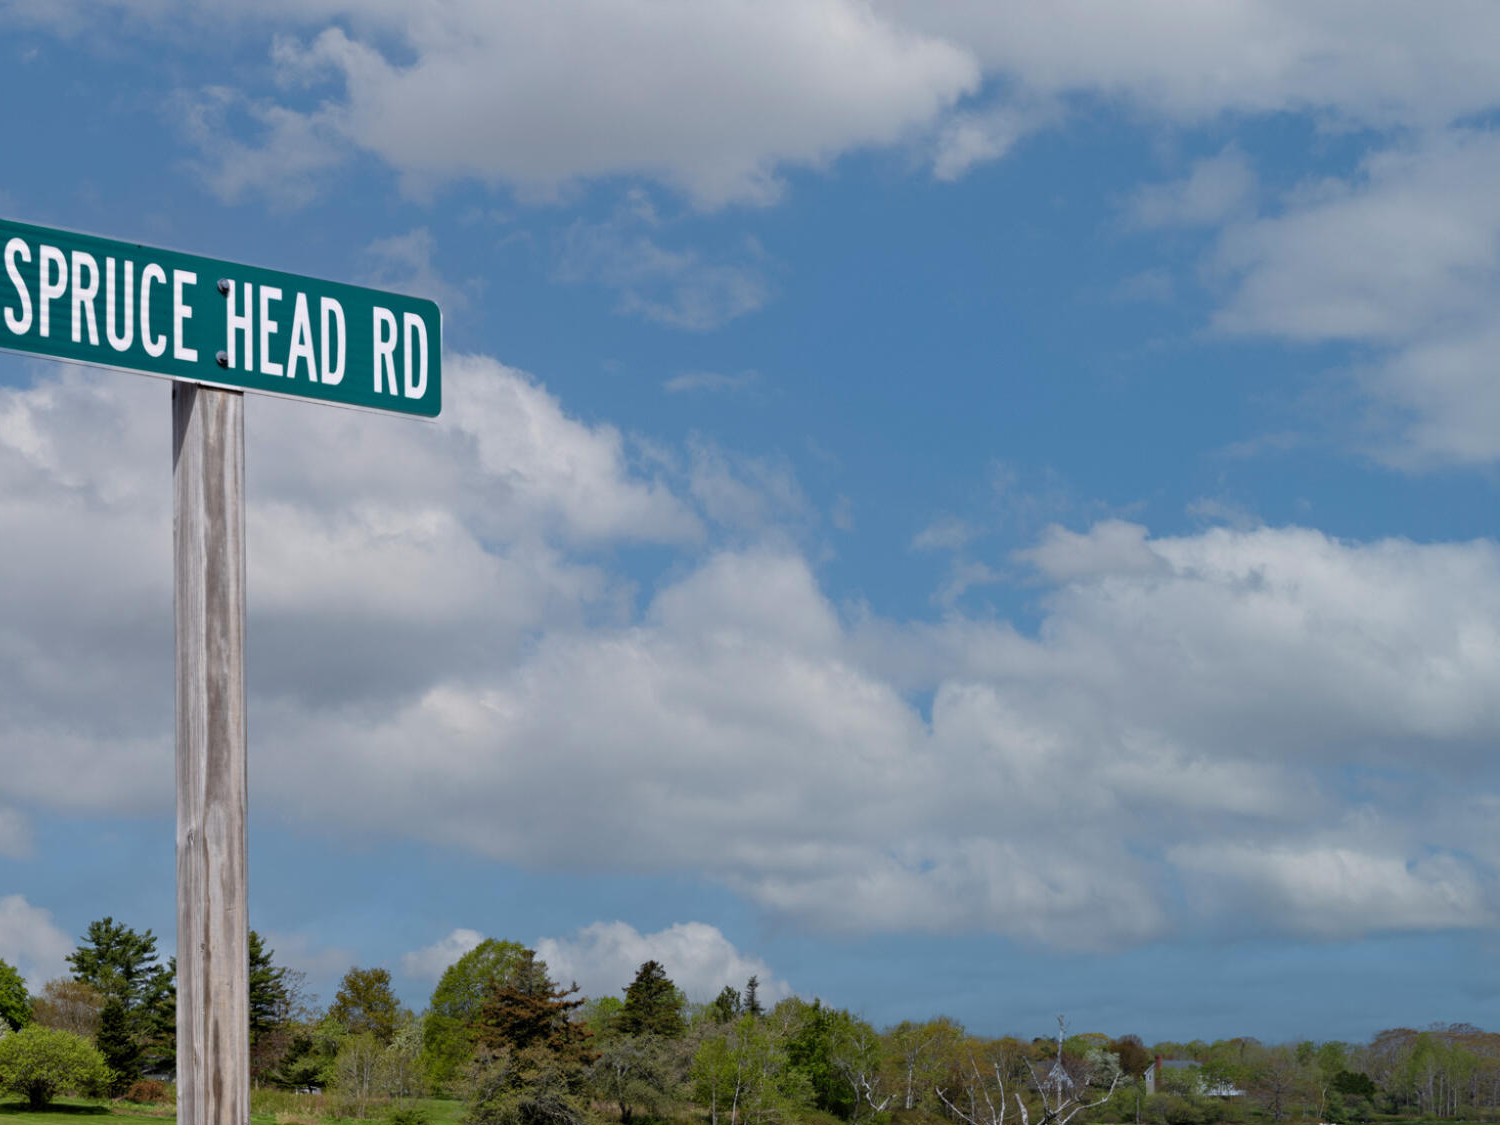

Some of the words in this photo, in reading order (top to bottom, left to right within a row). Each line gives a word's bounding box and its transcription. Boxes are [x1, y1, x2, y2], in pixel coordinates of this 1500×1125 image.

[3, 237, 199, 363] SPRUCE
[226, 278, 347, 386] HEAD
[372, 306, 429, 400] RD
